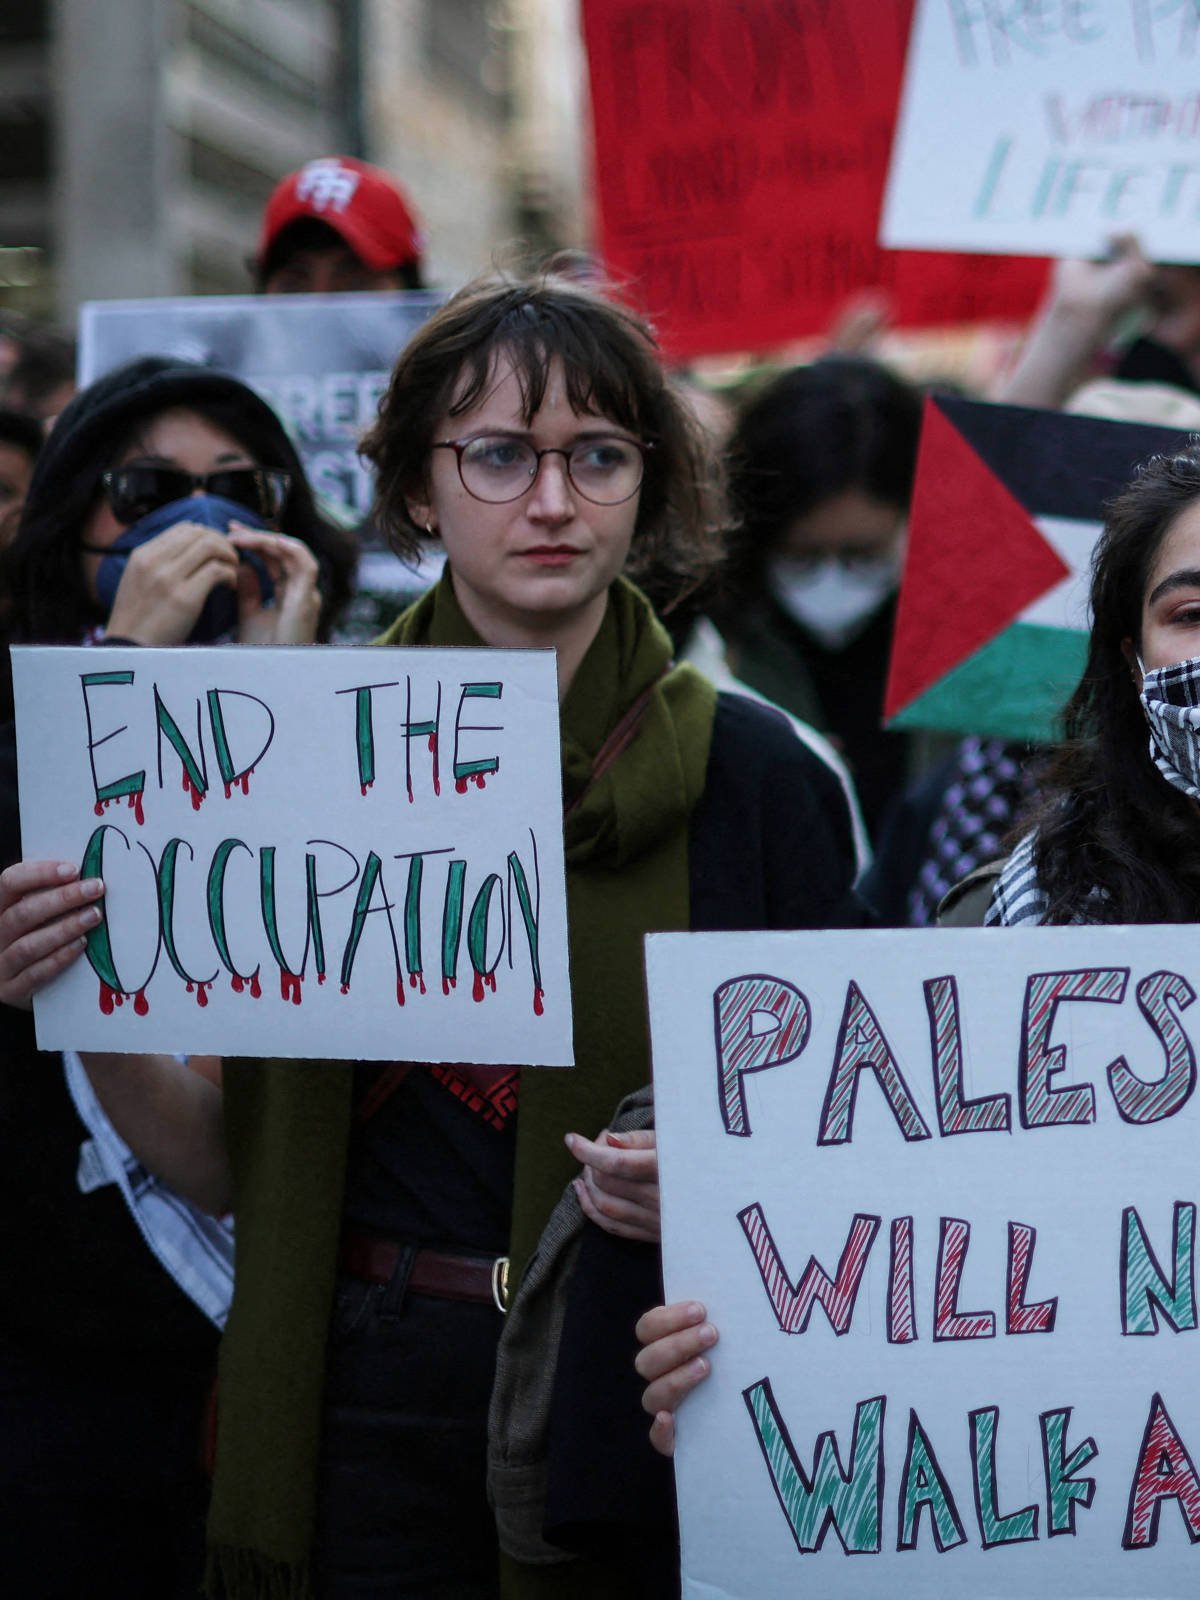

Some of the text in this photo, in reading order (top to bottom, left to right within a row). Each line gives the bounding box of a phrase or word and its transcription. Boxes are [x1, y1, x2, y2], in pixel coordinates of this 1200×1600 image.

[80, 670, 505, 824] END THE
[79, 824, 546, 1016] OCCUPATION
[737, 1202, 1059, 1344] WILL
[742, 1377, 1099, 1555] WALK
